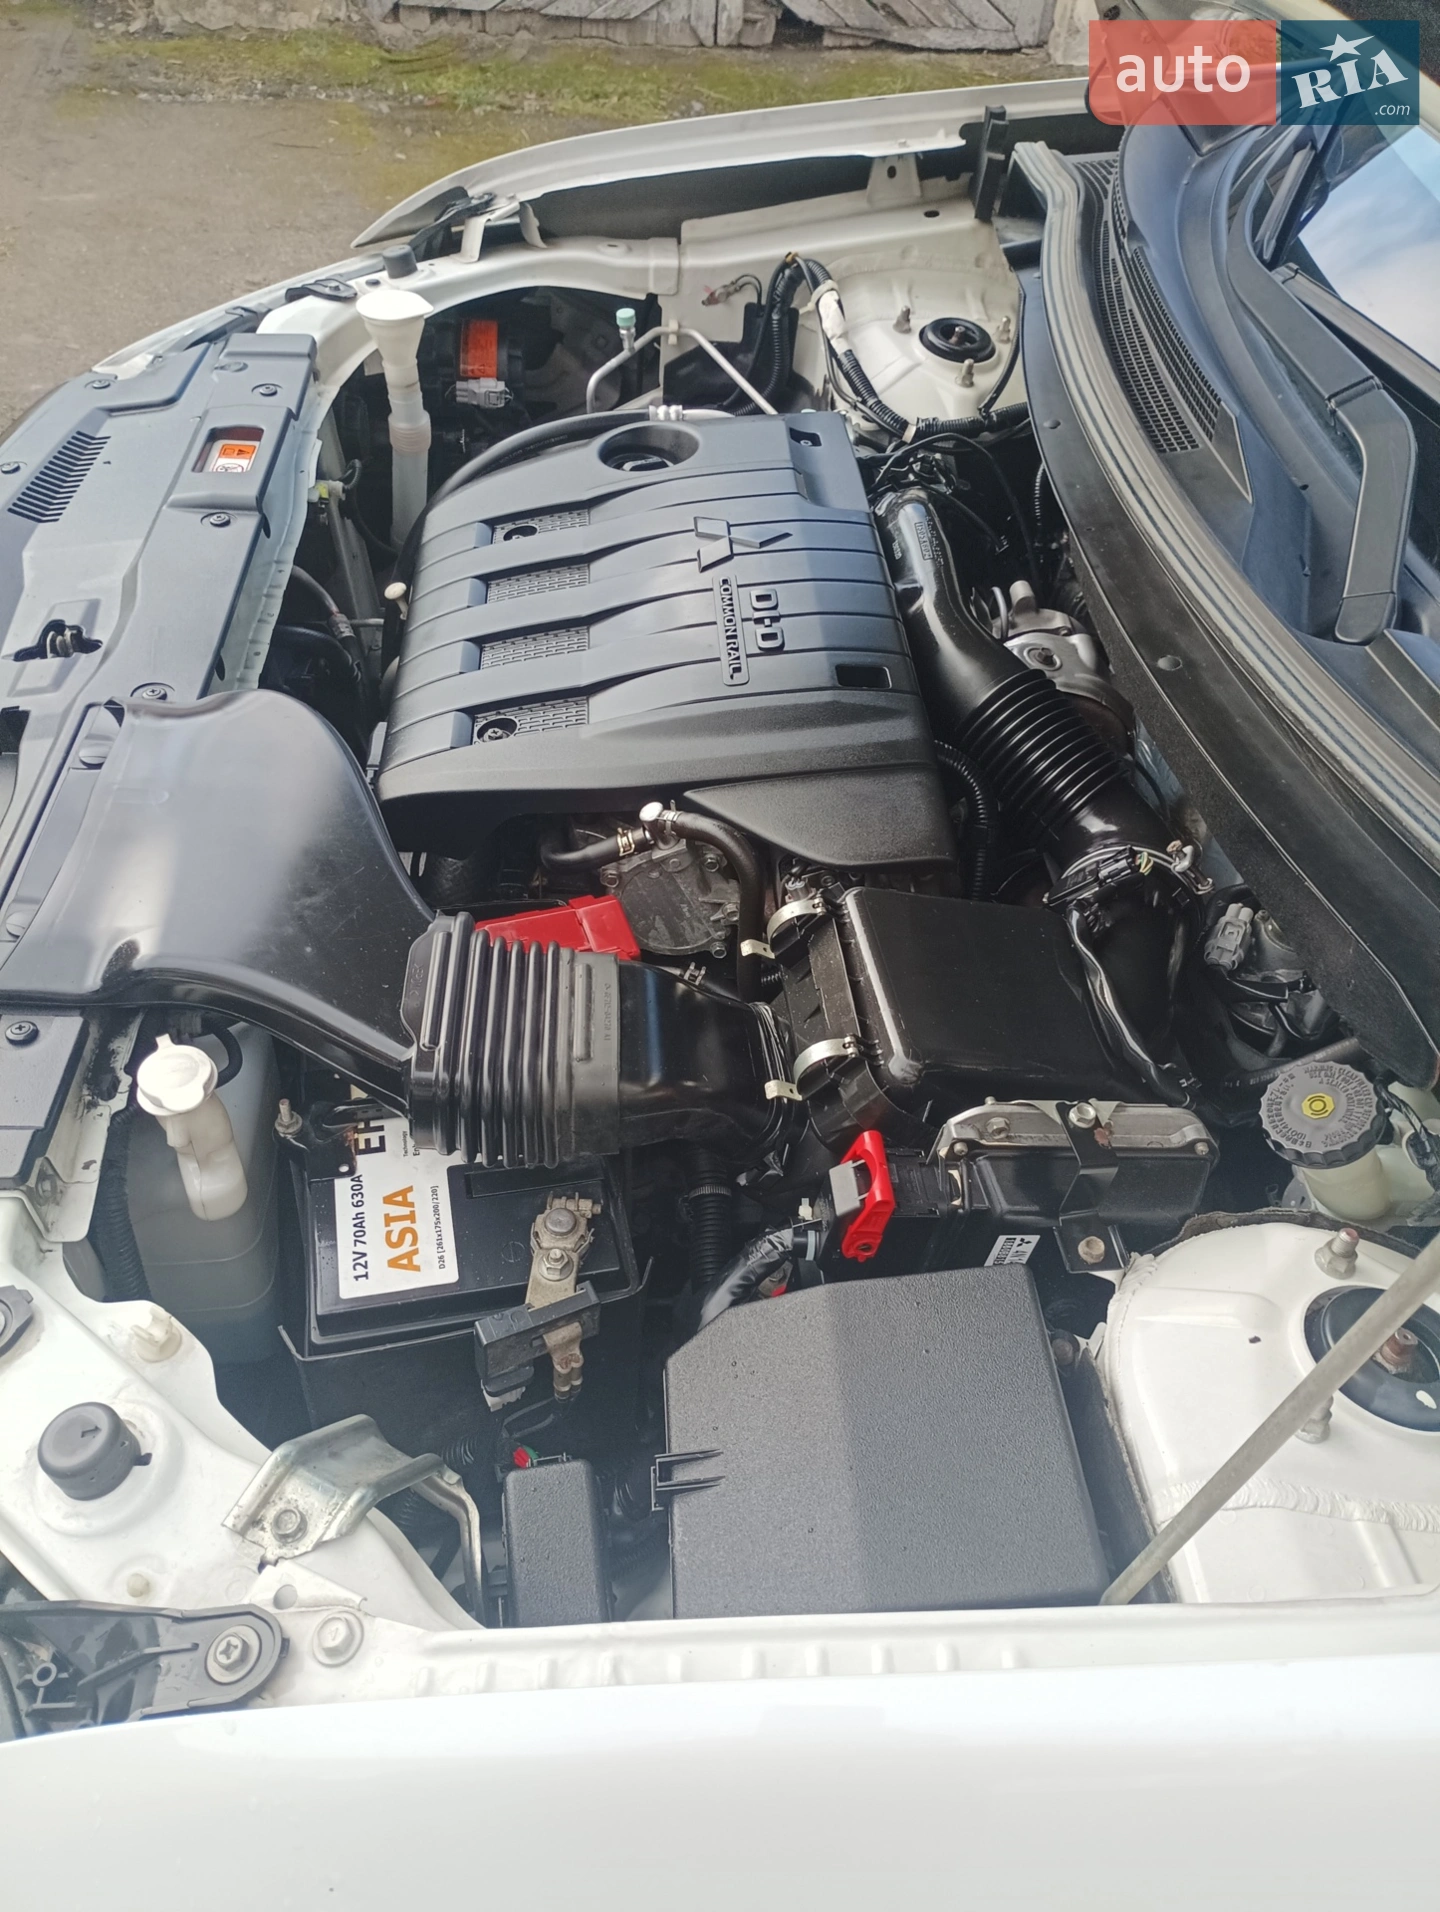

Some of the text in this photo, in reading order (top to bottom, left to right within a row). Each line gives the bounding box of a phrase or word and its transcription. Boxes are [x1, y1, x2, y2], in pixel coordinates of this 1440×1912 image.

[719, 576, 742, 675] COMMON RAIL
[750, 588, 785, 652] DI-D
[350, 1173, 369, 1282] 12V 70Ah 630A
[382, 1185, 421, 1272] ASIA
[438, 1257, 446, 1270] D26
